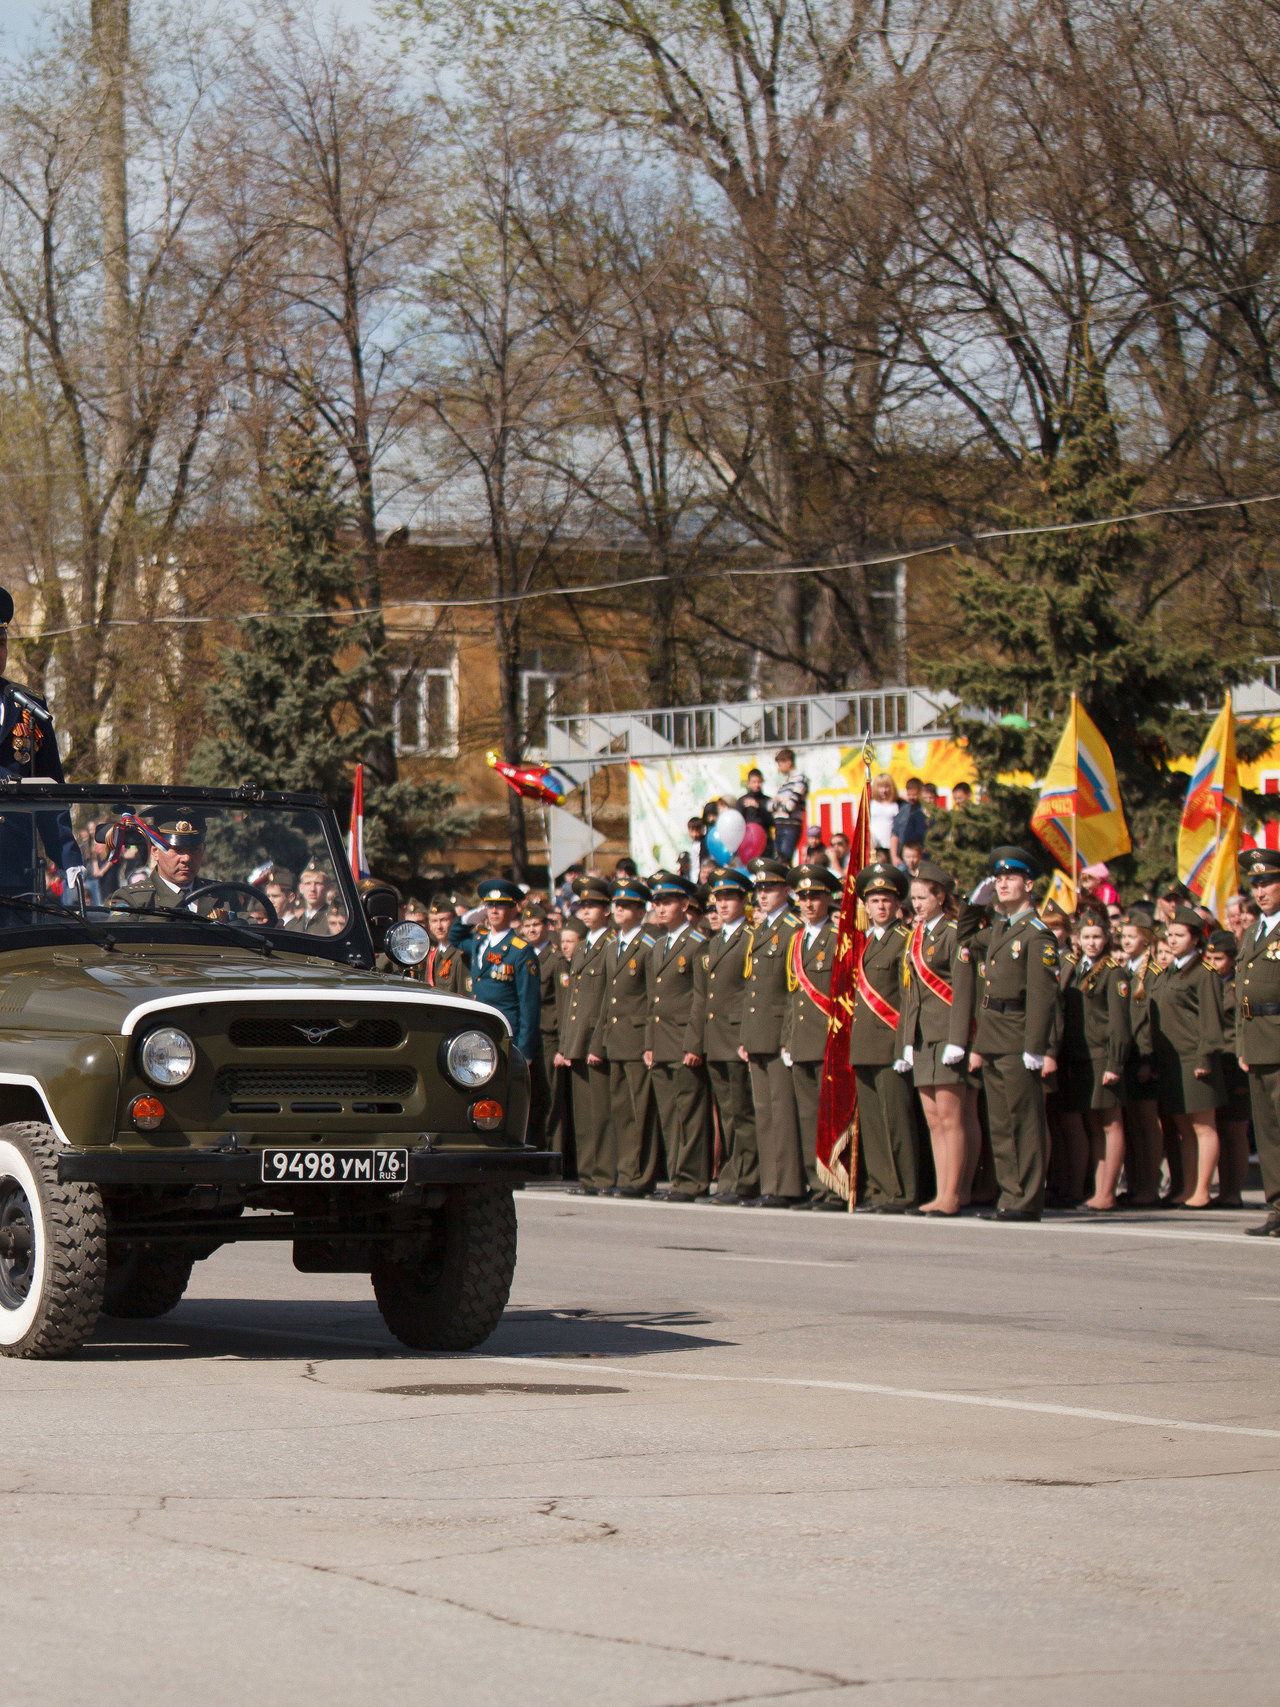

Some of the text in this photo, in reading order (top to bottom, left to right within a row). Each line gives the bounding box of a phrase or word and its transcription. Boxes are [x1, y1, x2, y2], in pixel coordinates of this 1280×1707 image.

[272, 1152, 336, 1179] 9498
[376, 1151, 400, 1172] 76
[379, 1171, 397, 1180] RUS
